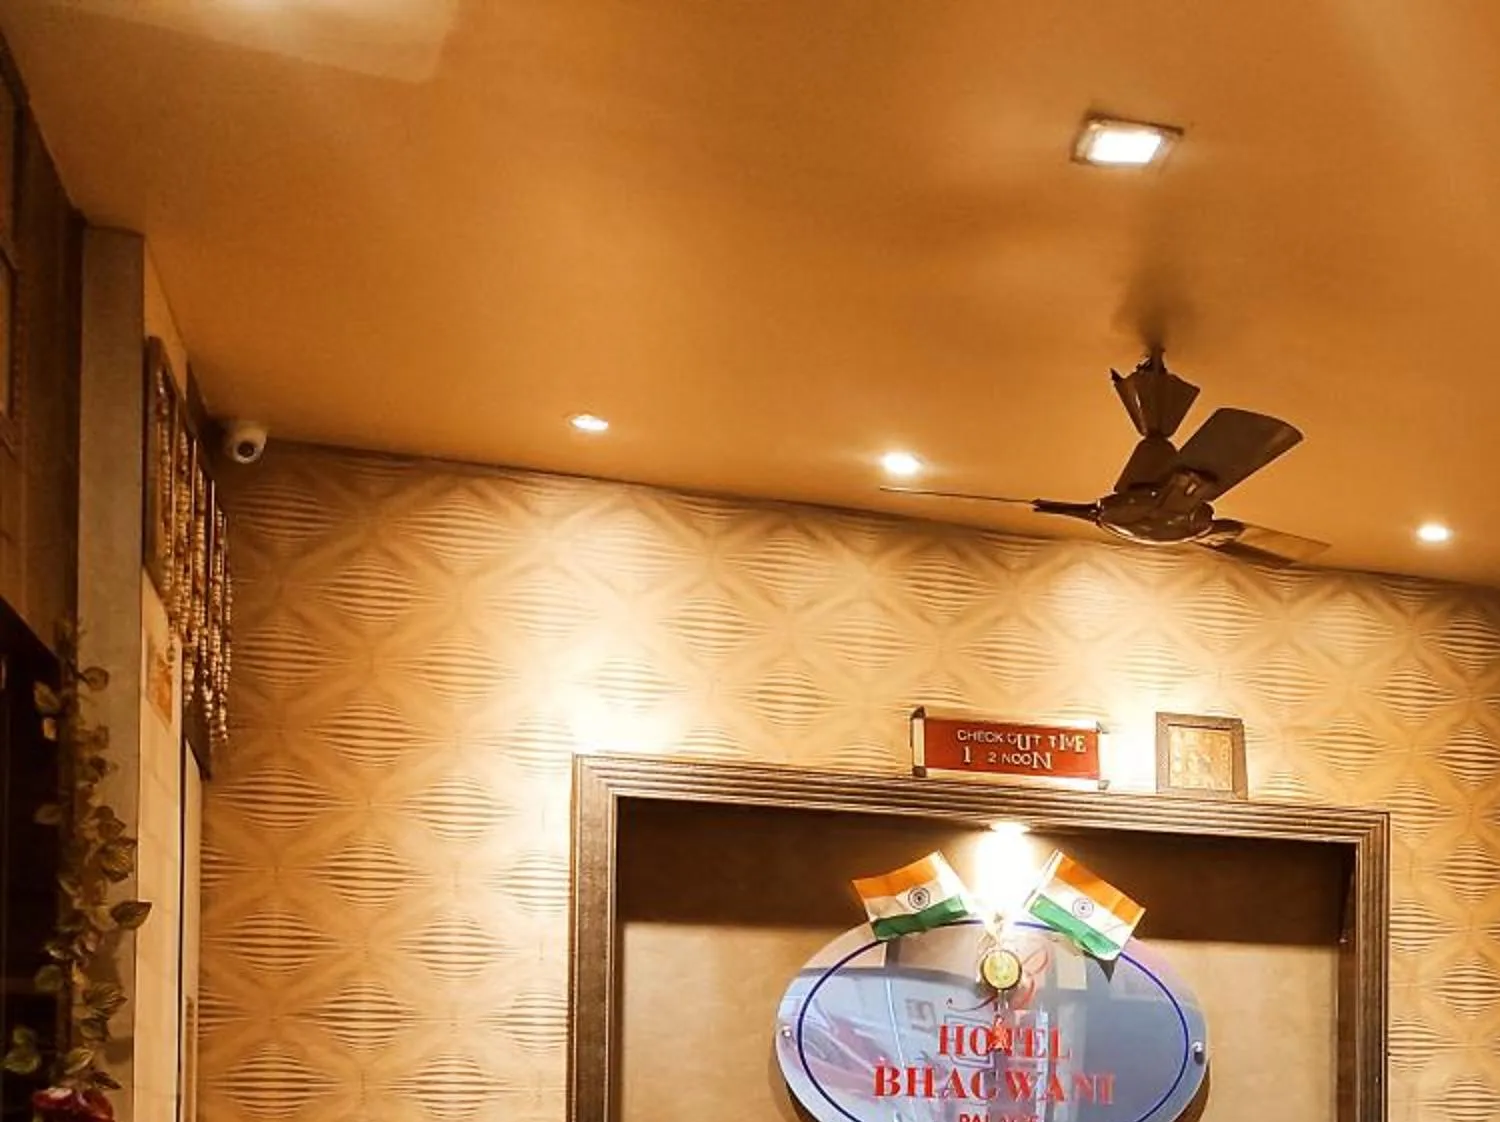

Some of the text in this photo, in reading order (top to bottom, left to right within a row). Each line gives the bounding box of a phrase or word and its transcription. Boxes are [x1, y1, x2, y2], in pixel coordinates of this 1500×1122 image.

[956, 729, 1087, 753] CHECK OUT TIME
[1001, 751, 1053, 770] NOON
[938, 1023, 1072, 1060] HOTEL
[872, 1062, 1117, 1106] BHAGWANI
